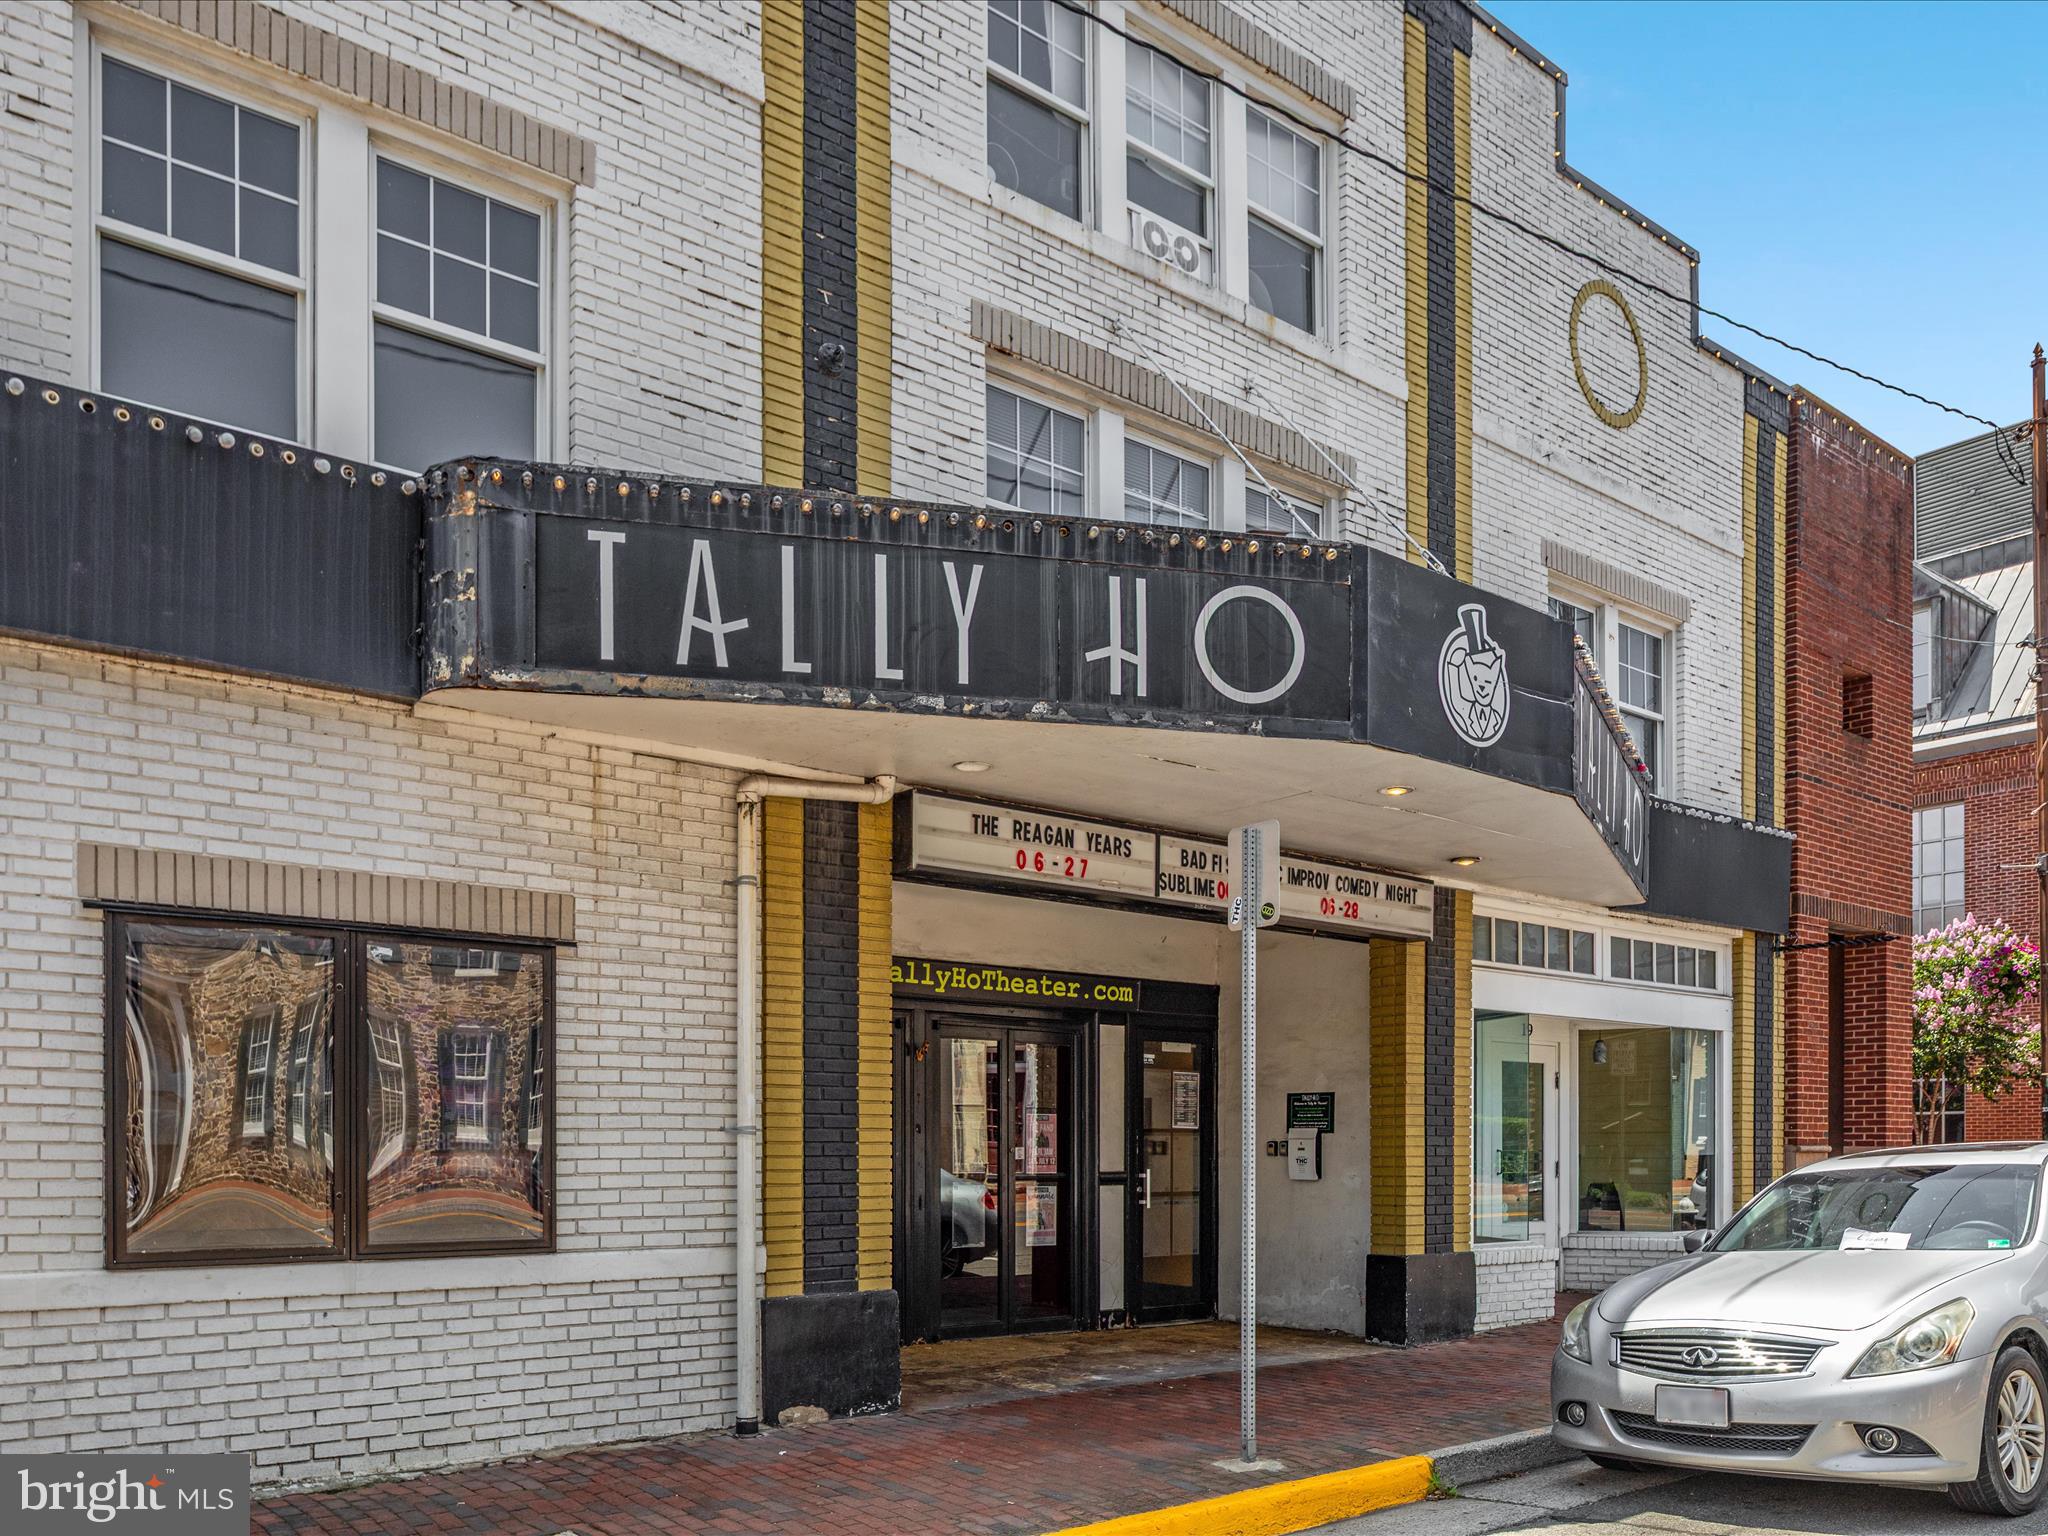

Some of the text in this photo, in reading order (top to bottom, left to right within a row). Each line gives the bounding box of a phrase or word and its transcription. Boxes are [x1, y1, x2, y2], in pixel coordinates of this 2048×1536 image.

[587, 529, 1305, 704] TALLY HO
[972, 813, 1132, 858] THE REAGAN YEARS
[1016, 850, 1088, 878] 06-27
[1181, 849, 1228, 874] BAD FI
[1160, 872, 1215, 898] SUBLIME
[1288, 867, 1330, 890] IMPROV
[1336, 875, 1379, 898] COMEDY
[1386, 884, 1417, 905] NIGHT
[1232, 898, 1242, 923] THC
[1320, 897, 1359, 919] 06-28
[890, 961, 1134, 1003] allyHoTheater.com
